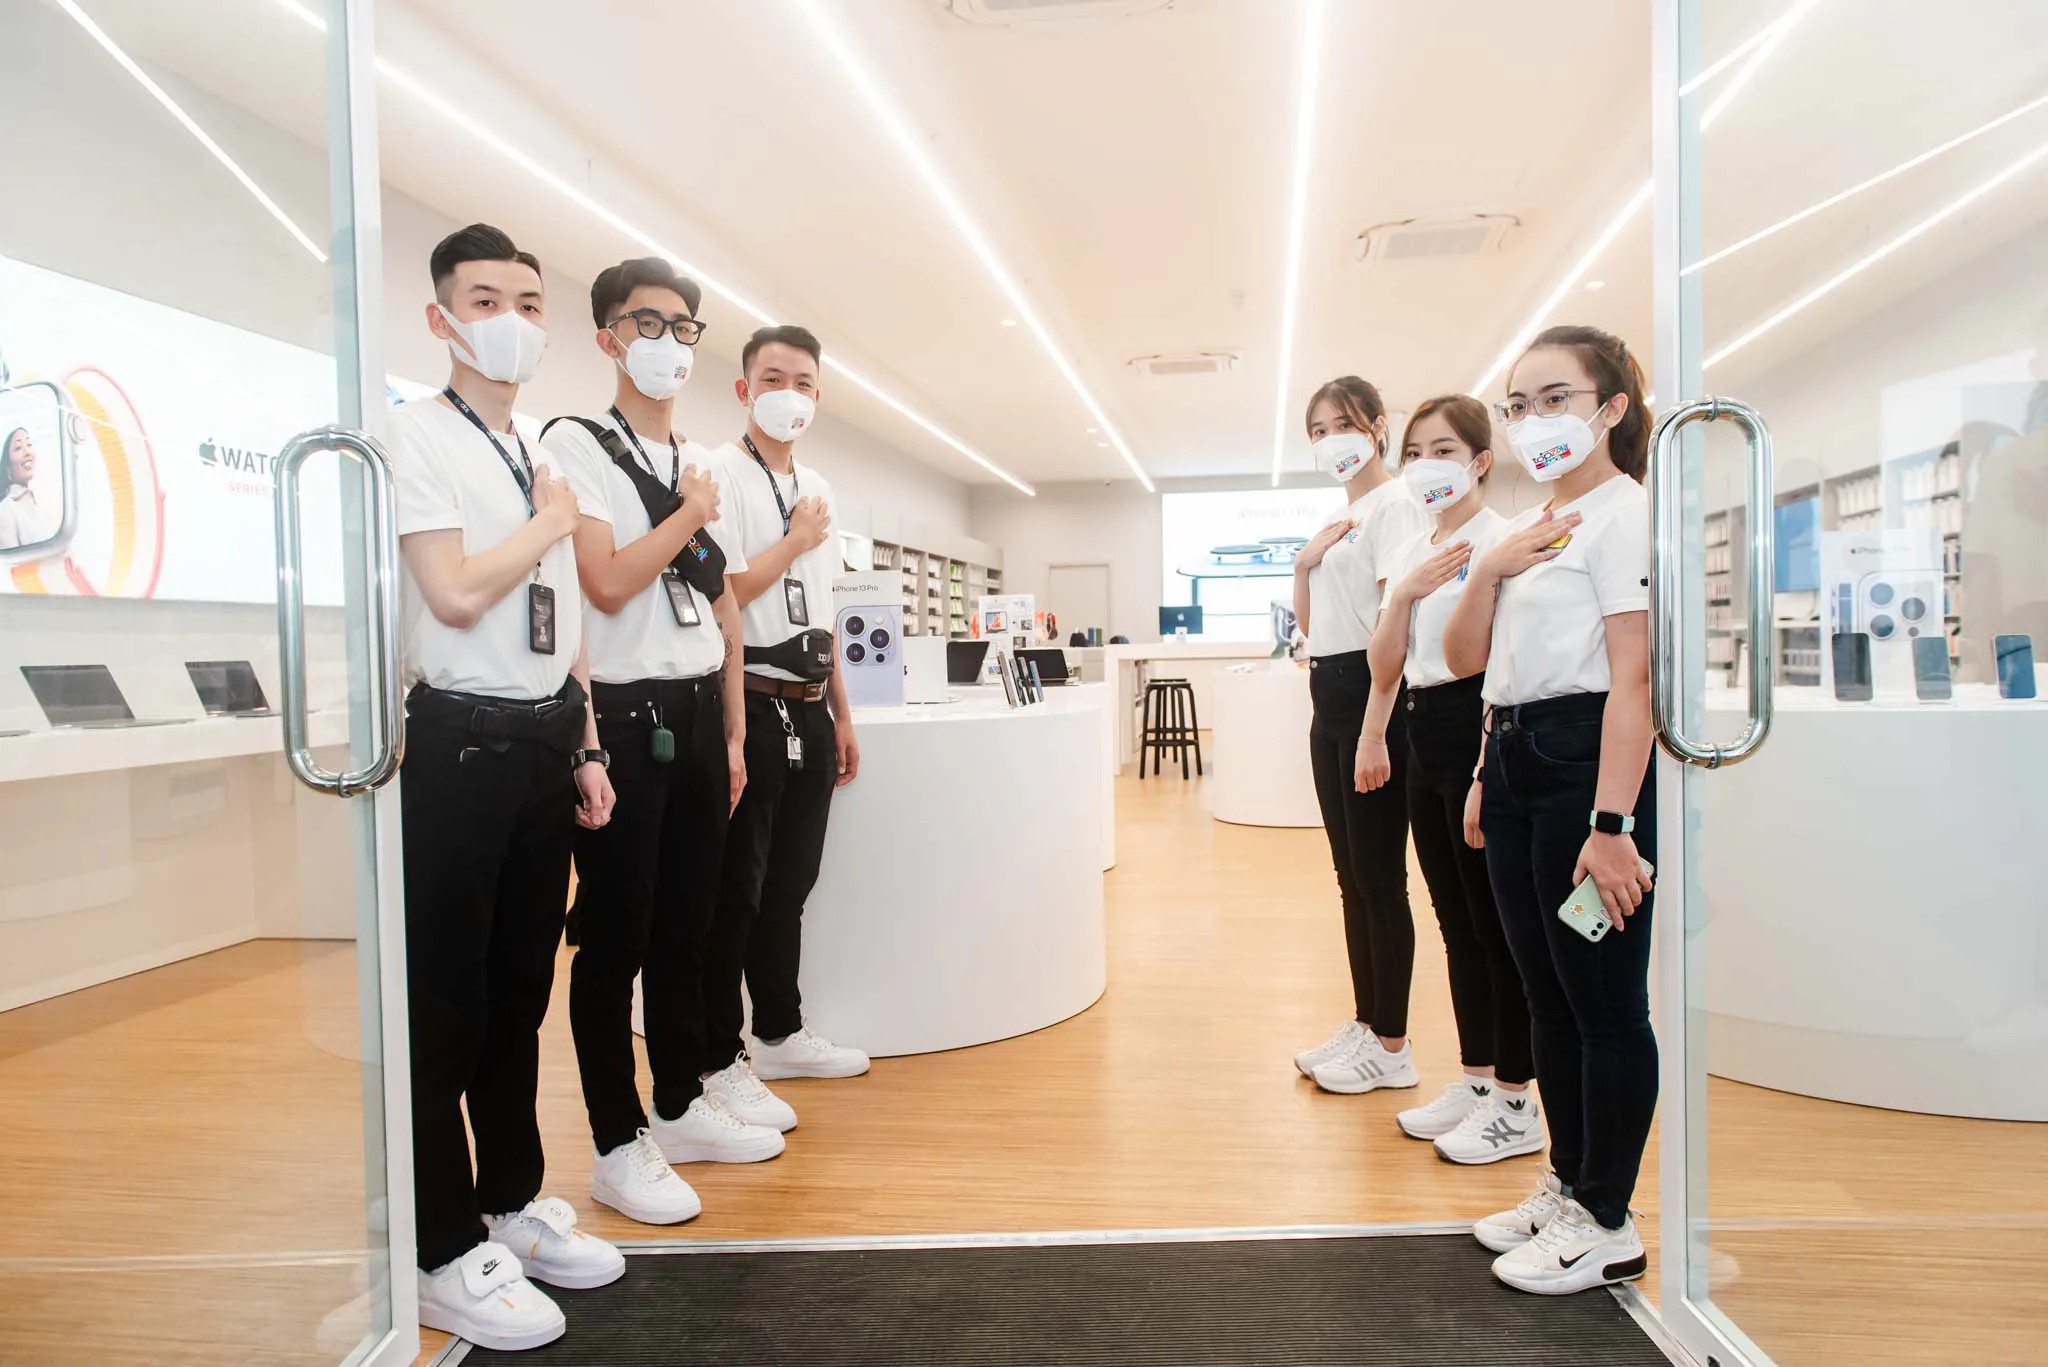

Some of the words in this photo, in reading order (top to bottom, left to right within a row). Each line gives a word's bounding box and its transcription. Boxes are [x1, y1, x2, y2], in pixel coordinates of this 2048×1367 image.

[220, 446, 281, 476] WATC
[859, 584, 867, 592] 13
[867, 584, 879, 592] Pro
